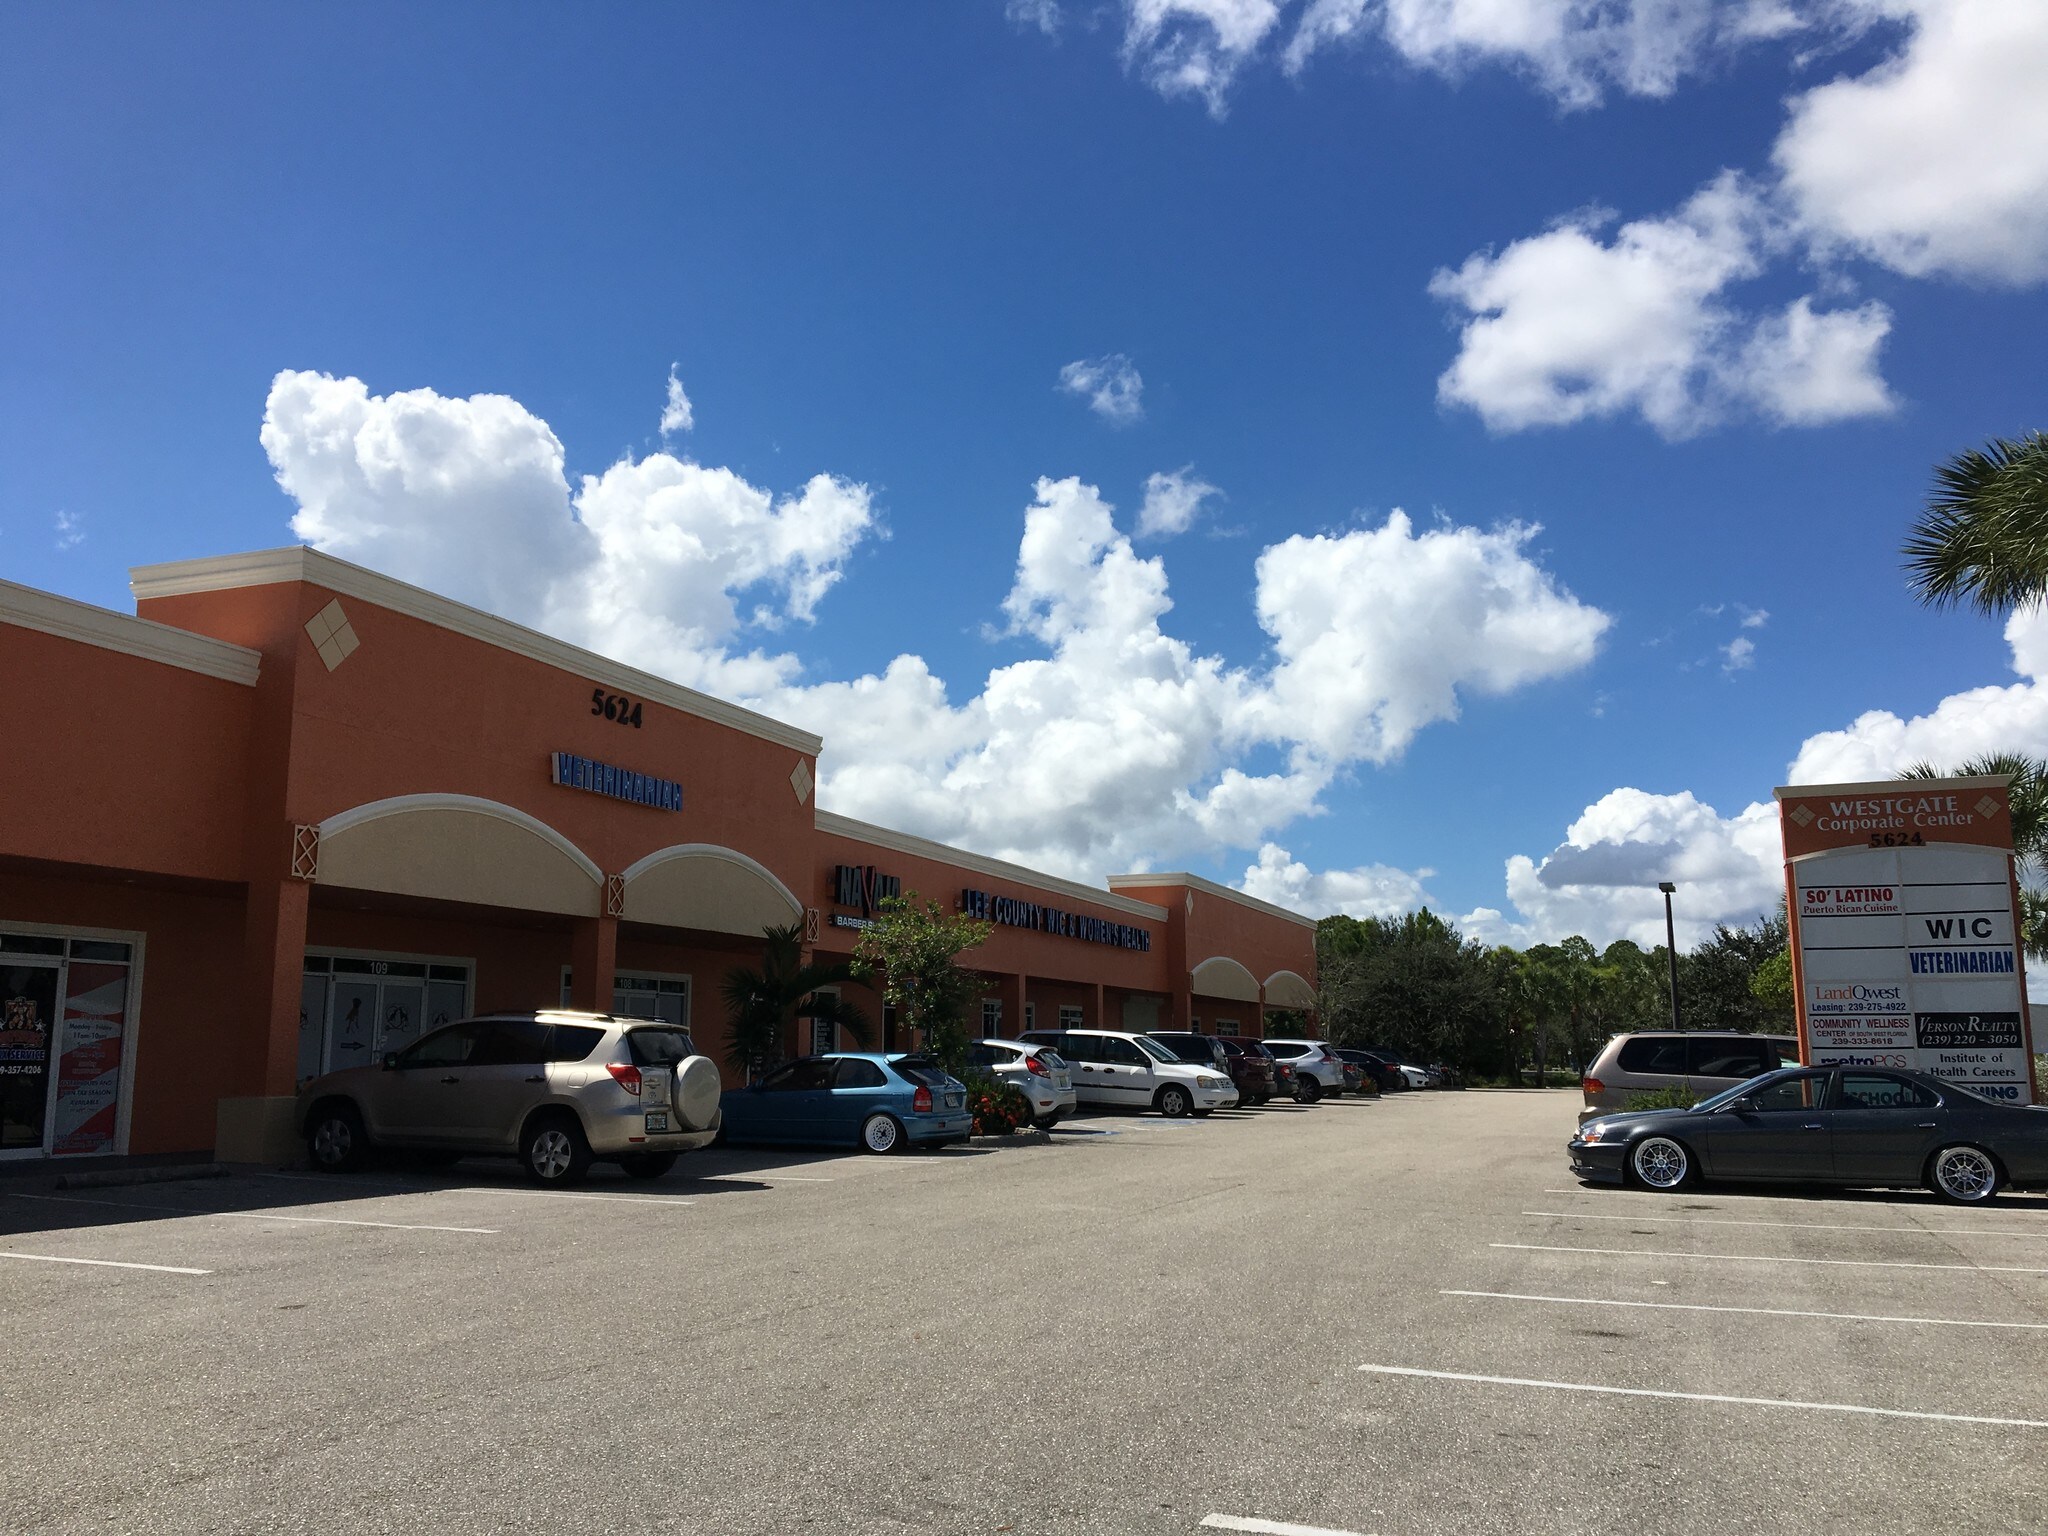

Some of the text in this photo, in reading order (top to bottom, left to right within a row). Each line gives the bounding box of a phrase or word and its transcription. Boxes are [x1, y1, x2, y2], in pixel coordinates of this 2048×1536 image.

[591, 688, 642, 728] 5624
[552, 752, 683, 812] VETERINARIAN
[1829, 796, 1958, 818] WESTGATE
[1816, 812, 1974, 833] Corporate Center
[1869, 831, 1924, 847] 5624
[1806, 888, 1894, 904] SO' LATINO
[1803, 903, 1899, 914] Puerto Rican Cuisine
[837, 916, 867, 929] BARBER
[965, 889, 1151, 952] LEE COUNTY WIC & WOMEN'S HEALTH
[1925, 917, 1993, 939] WIC
[370, 961, 388, 975] 109
[1909, 951, 2014, 974] VETERINARIAN
[620, 978, 632, 989] 108
[1815, 984, 1901, 1001] LandQwest
[1812, 1002, 1907, 1012] Leasing: 239-275-4922
[1812, 1018, 1910, 1029] COMMUNITY WELLNESS
[1919, 1016, 2018, 1033] VERSON REALTY
[1921, 1034, 1951, 1045] (239)
[1953, 1034, 1976, 1044] 220
[1987, 1034, 2018, 1044] 3050
[10, 1049, 45, 1061] SERVICE
[1939, 1053, 2003, 1063] Institute of
[1930, 1067, 2016, 1077] Health Careers
